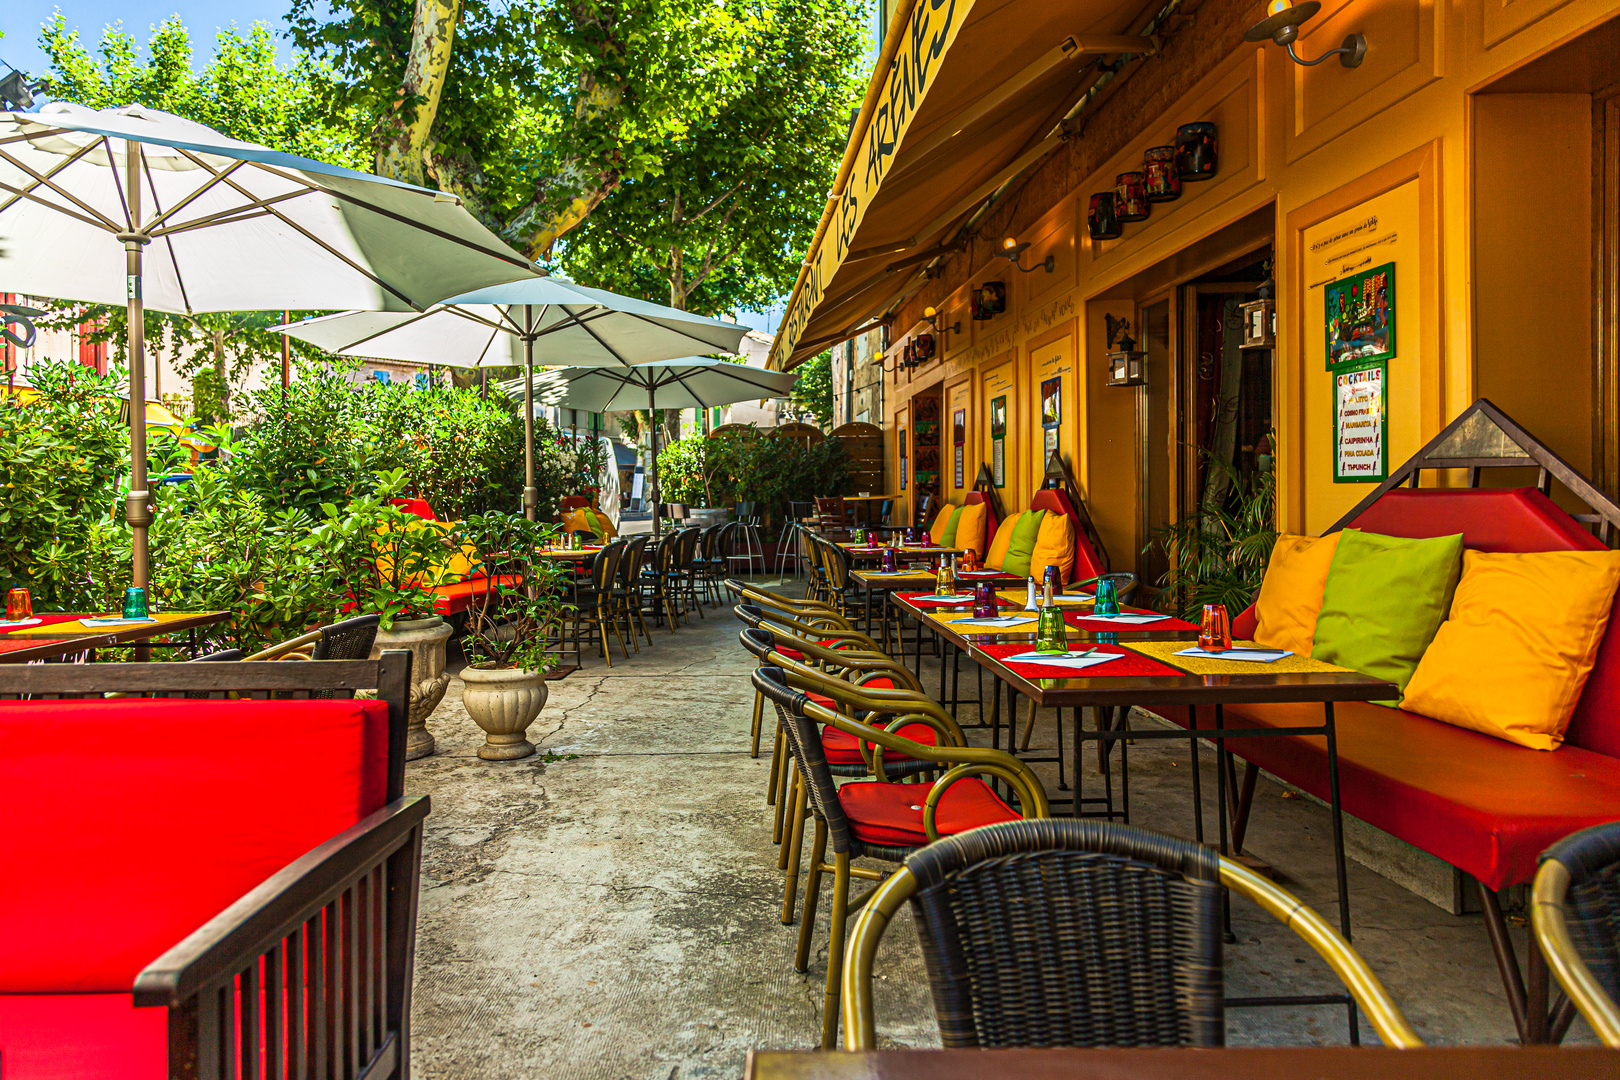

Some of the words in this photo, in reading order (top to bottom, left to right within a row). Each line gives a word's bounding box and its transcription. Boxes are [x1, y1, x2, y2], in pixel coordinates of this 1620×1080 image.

[836, 172, 858, 263] LES
[1337, 369, 1381, 387] COCKTAILS
[1345, 420, 1372, 429] MARGARITA
[1344, 436, 1374, 445] CAIPIRINHA
[1355, 449, 1375, 457] COLADA
